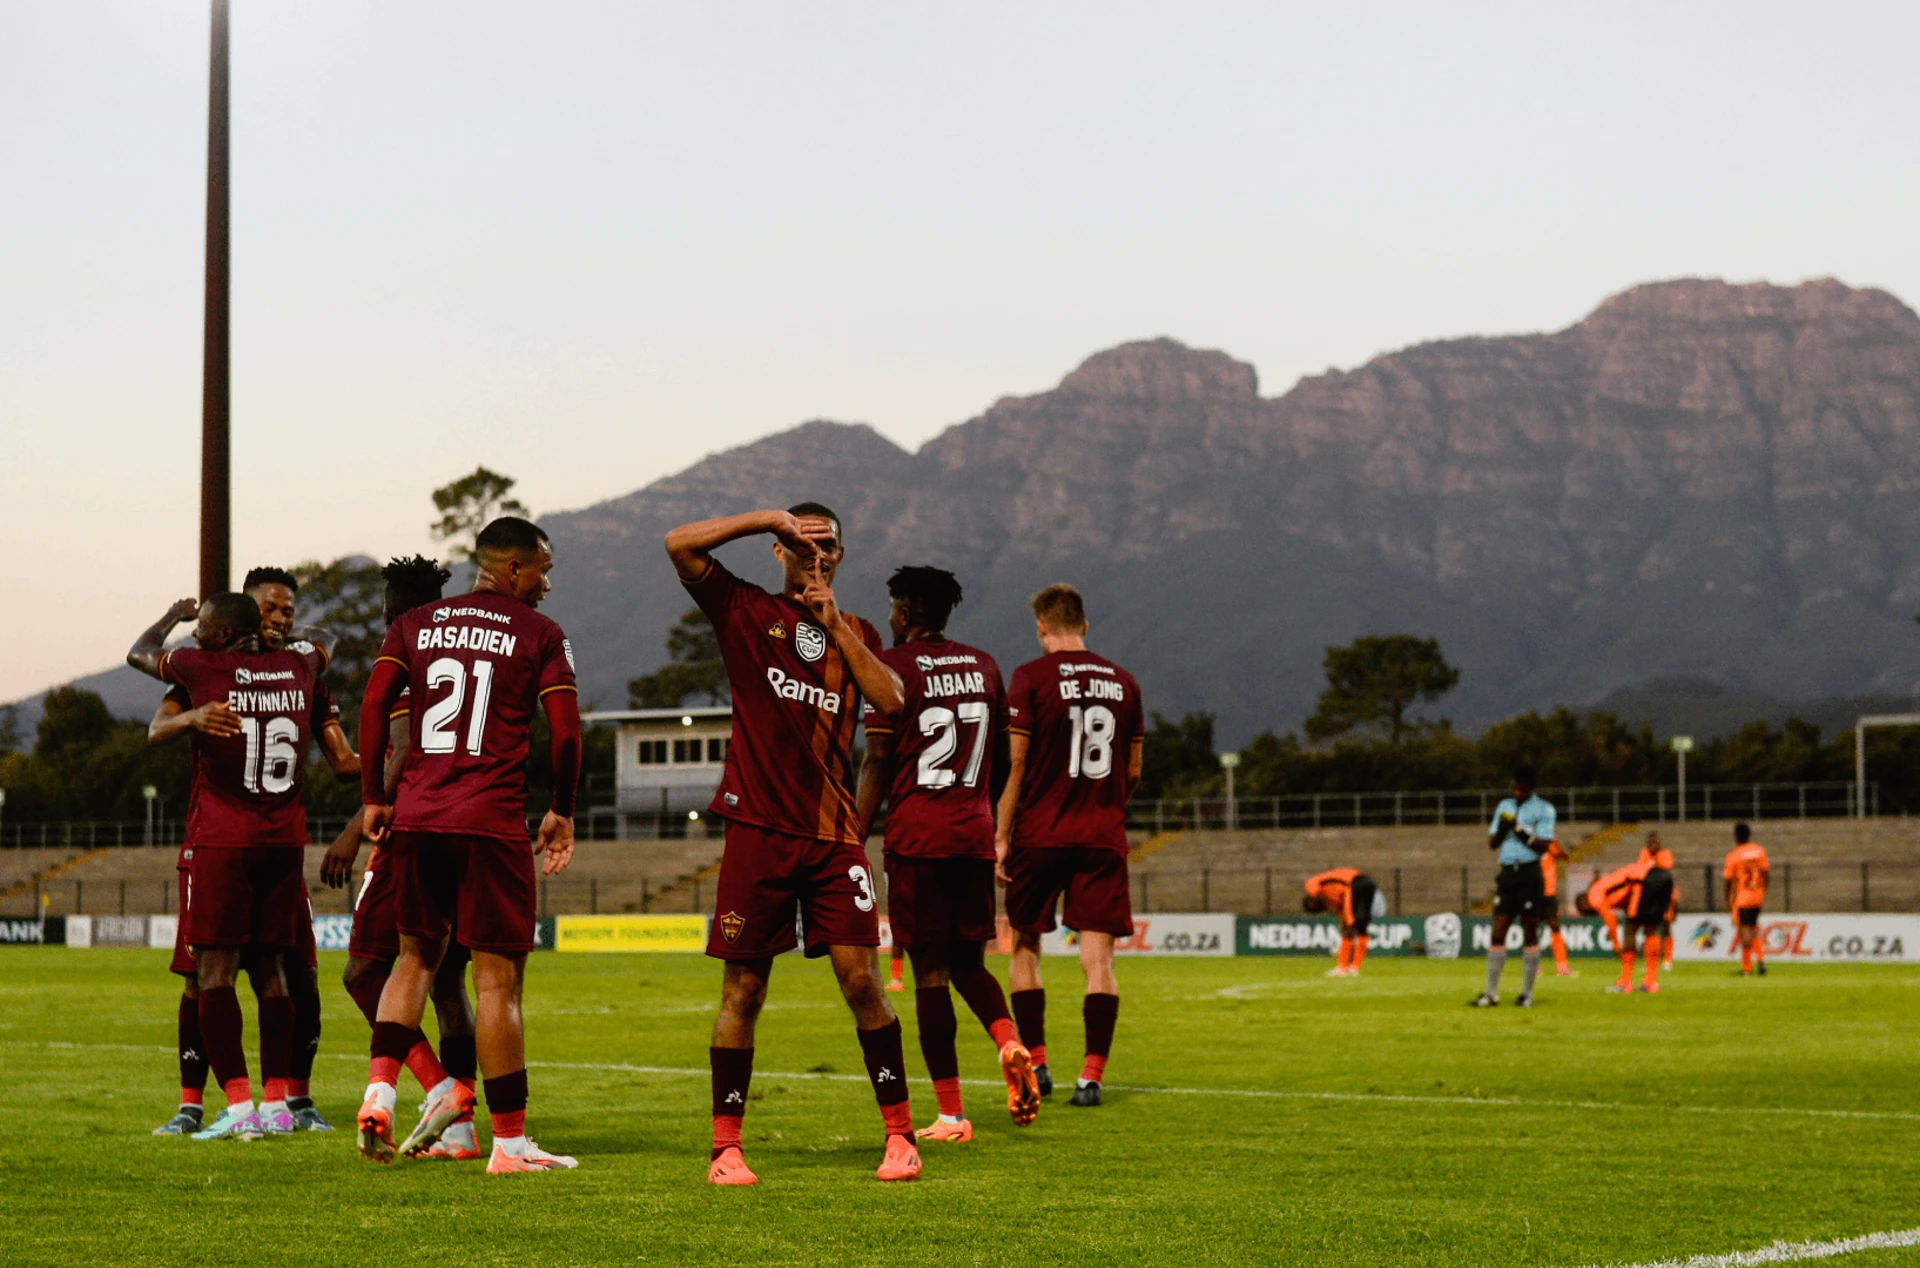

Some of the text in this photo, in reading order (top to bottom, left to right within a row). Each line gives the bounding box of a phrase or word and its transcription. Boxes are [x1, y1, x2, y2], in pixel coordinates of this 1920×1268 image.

[451, 607, 512, 625] NEDBANK
[417, 625, 517, 657] BASADIEN
[933, 655, 977, 667] NEDBANK
[252, 670, 295, 682] NEDBANK
[923, 671, 985, 698] JABAAR
[1058, 678, 1125, 702] DE JONG
[228, 690, 306, 712] ENYINNAYA
[767, 667, 841, 714] Rama
[420, 657, 495, 757] 21
[241, 716, 299, 794] 16
[917, 702, 990, 790] 27
[1068, 705, 1116, 780] 18
[1249, 923, 1343, 951] NEDBAN
[1367, 924, 1412, 949] CUP
